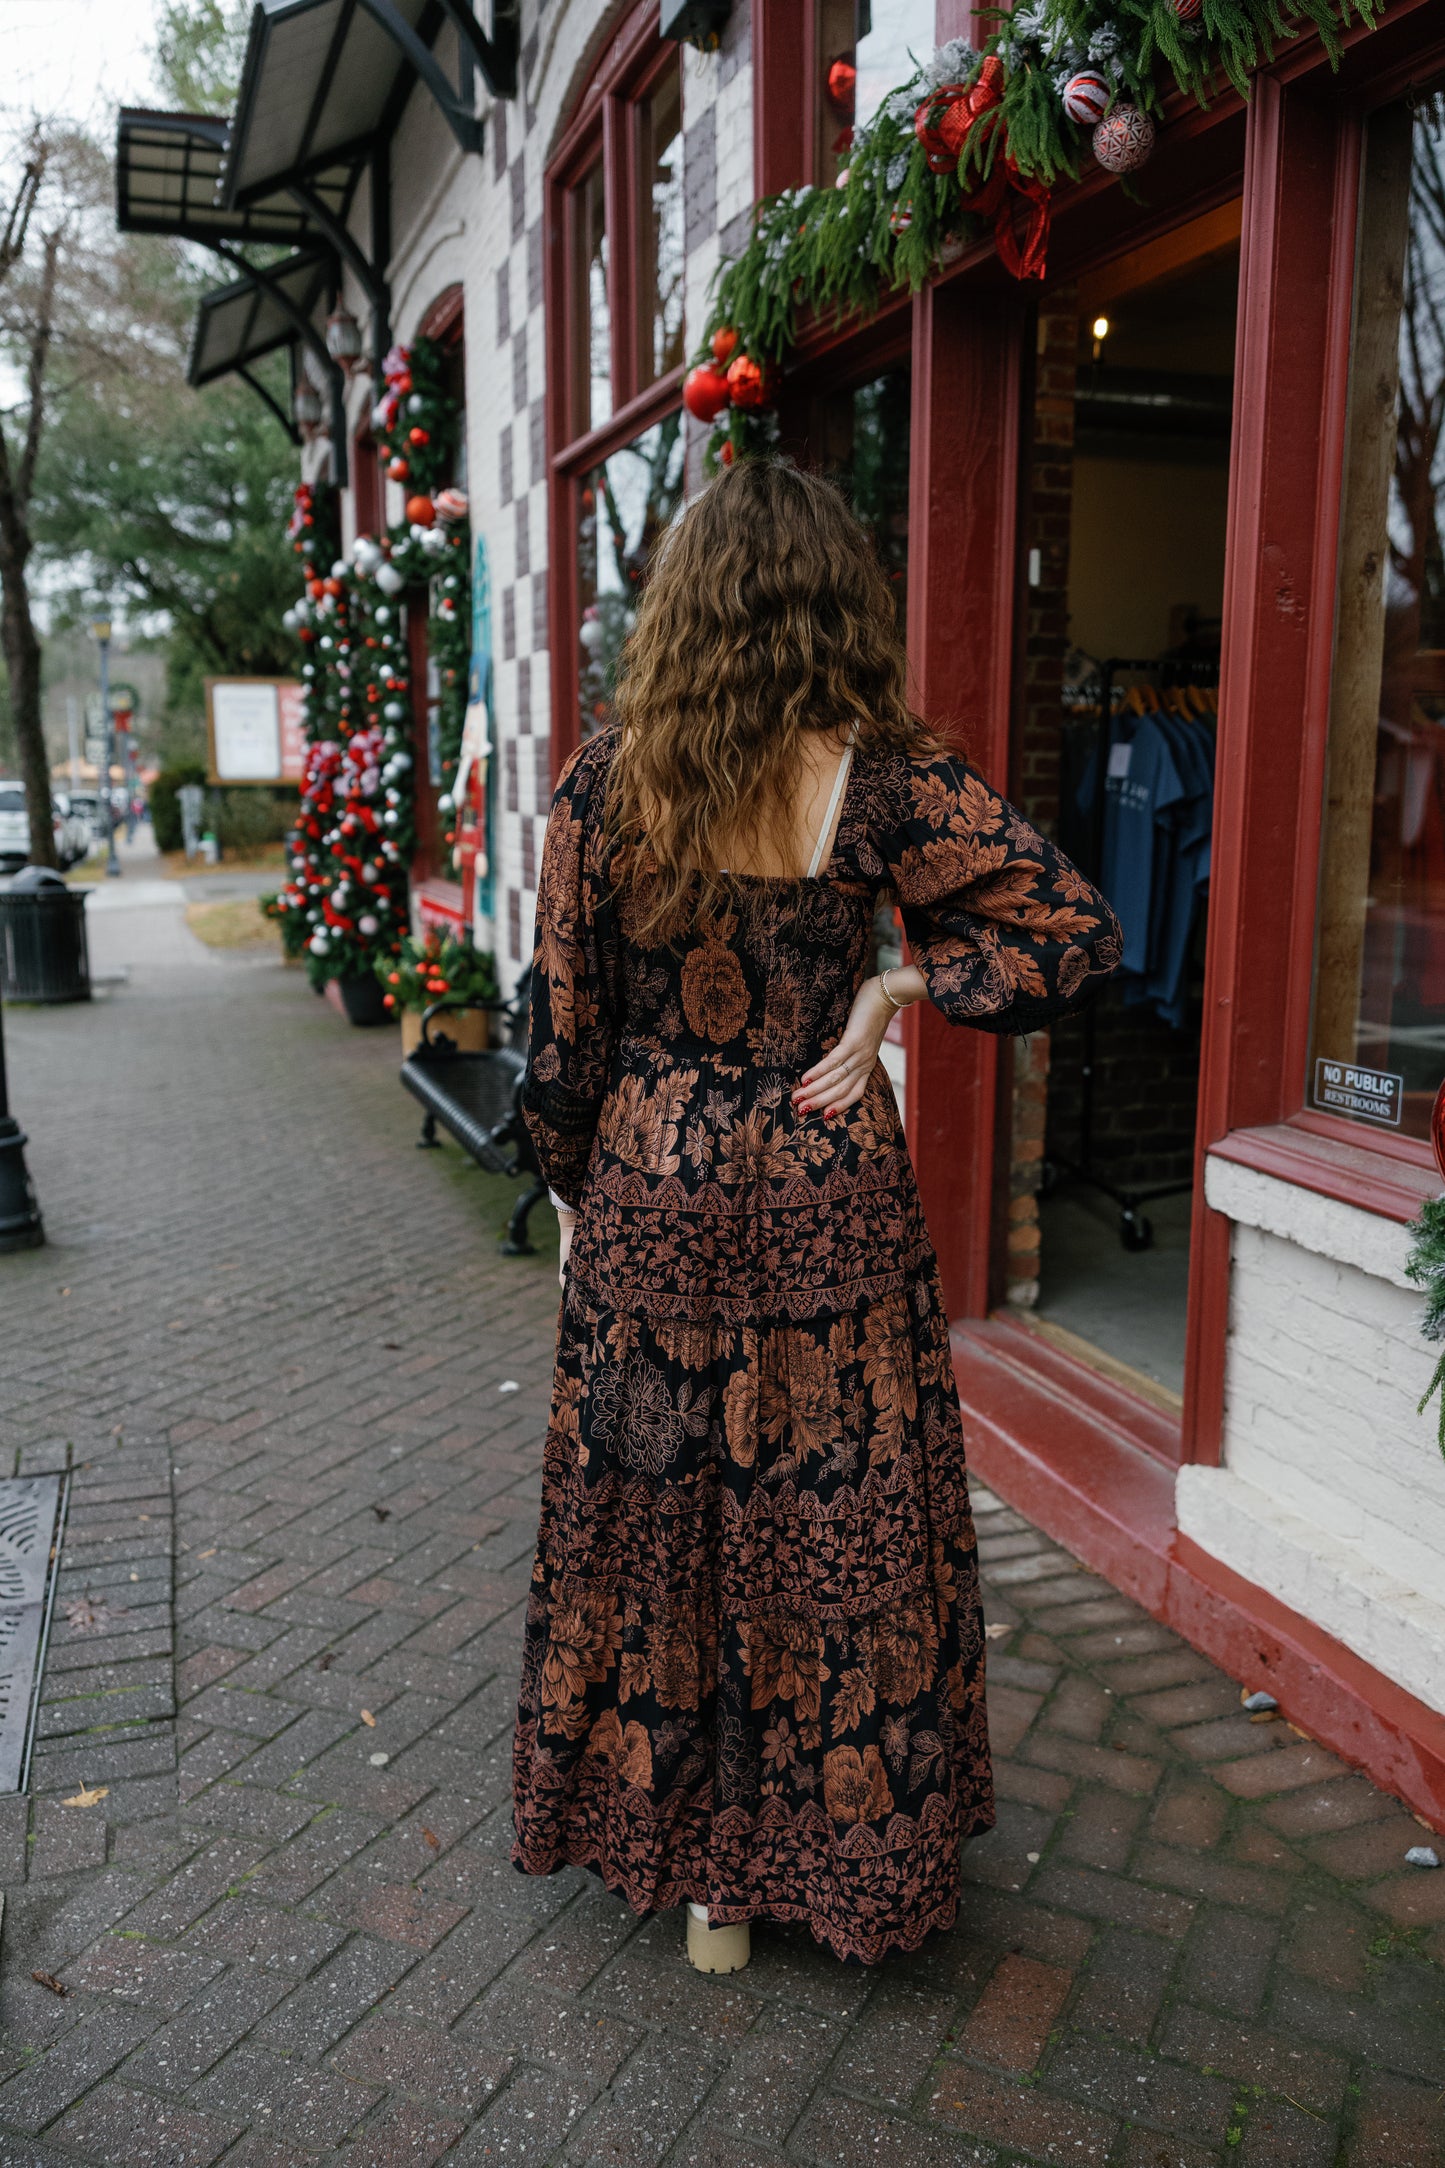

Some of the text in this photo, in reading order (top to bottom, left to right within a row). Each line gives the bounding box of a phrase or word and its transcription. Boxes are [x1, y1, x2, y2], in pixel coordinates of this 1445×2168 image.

[1323, 1065, 1394, 1096] NO PUBLIC
[1324, 1088, 1391, 1116] RESTROOMS
